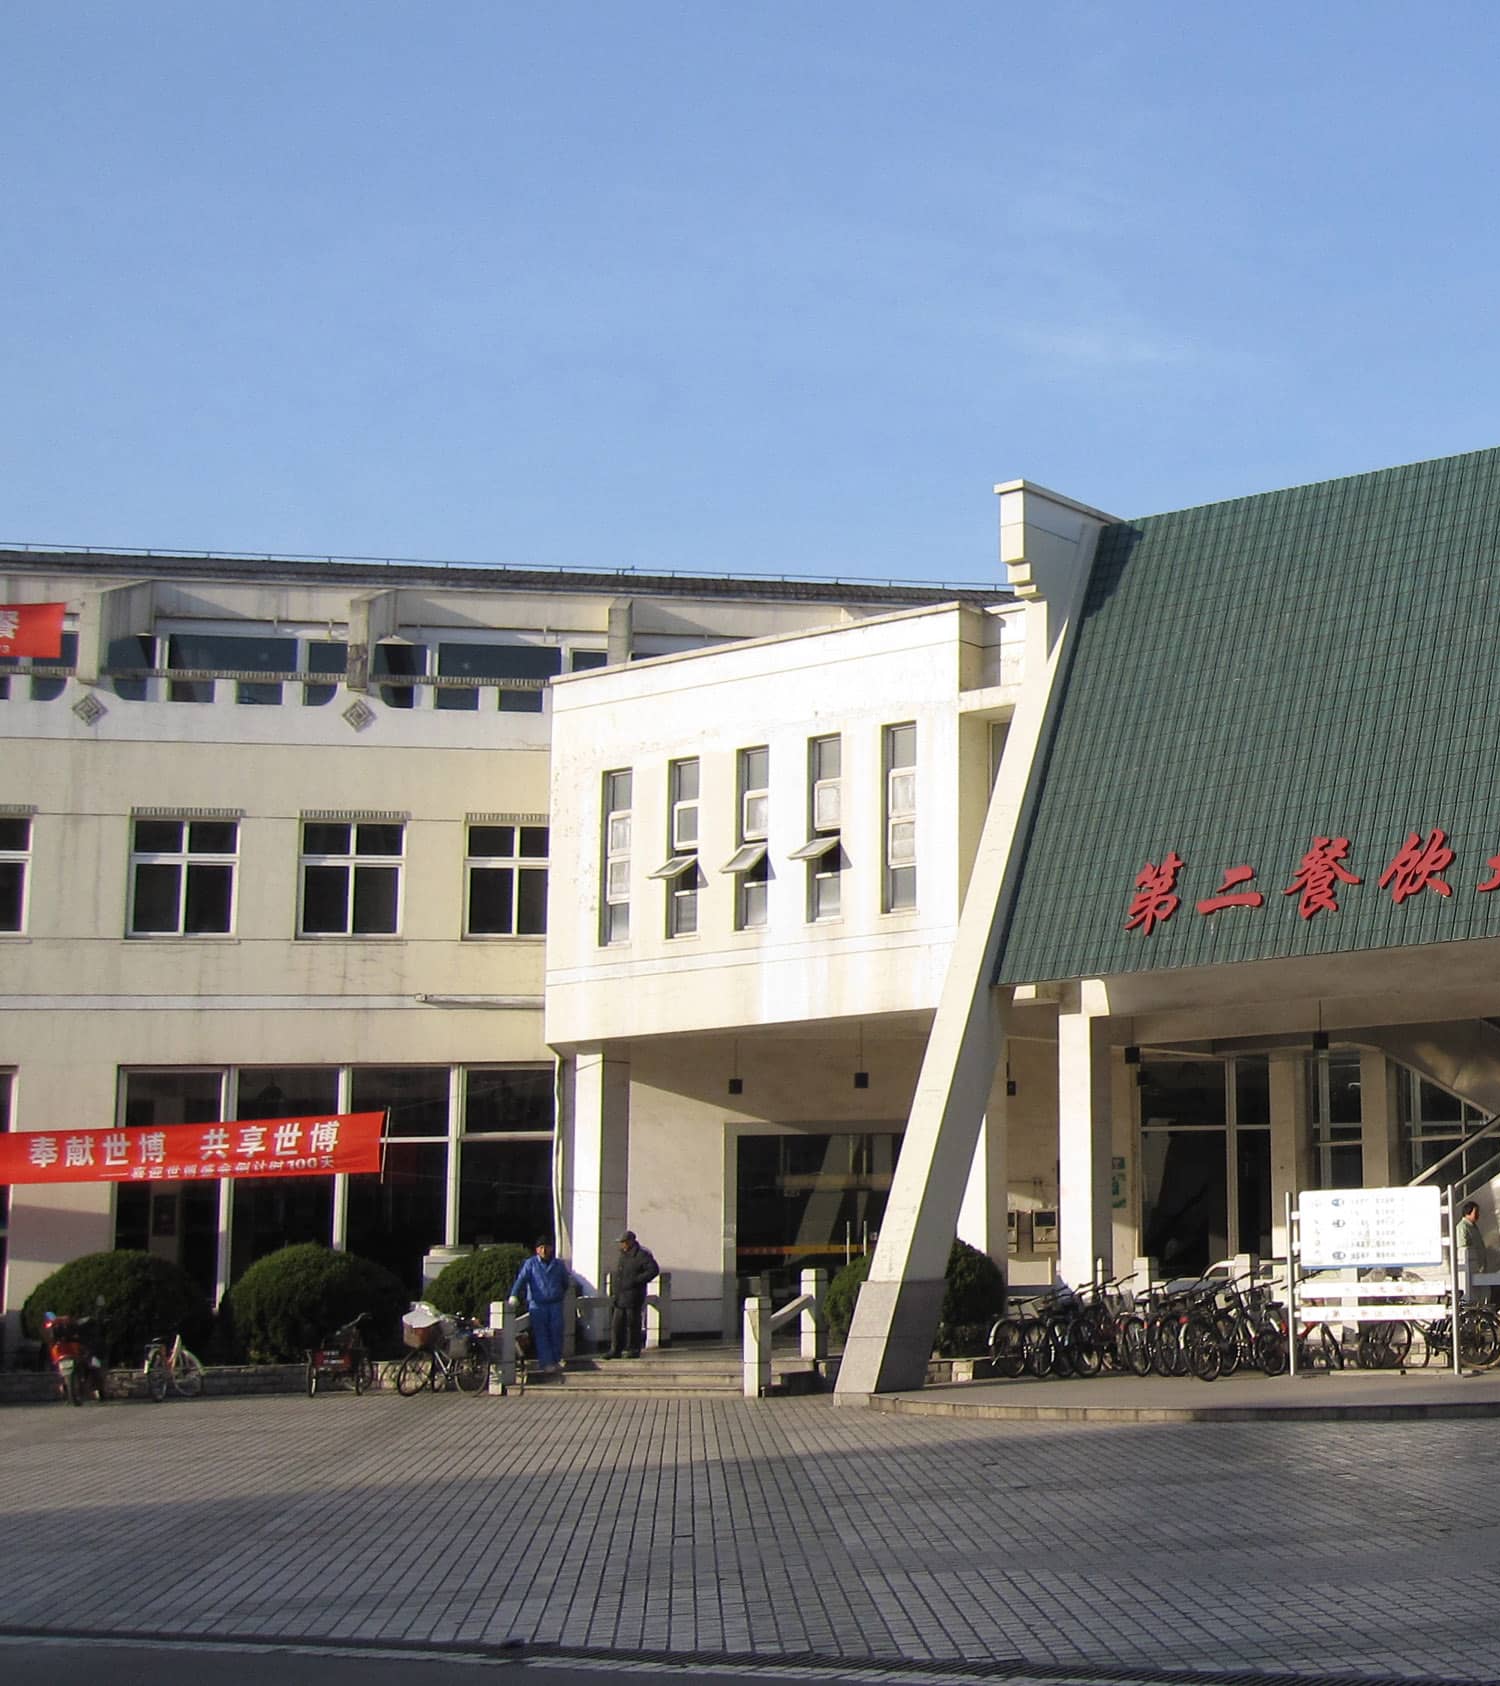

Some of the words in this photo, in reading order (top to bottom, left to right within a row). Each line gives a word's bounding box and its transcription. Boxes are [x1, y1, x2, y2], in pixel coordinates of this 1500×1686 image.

[29, 1132, 167, 1168] 奉献世博
[199, 1120, 340, 1161] 共享世博
